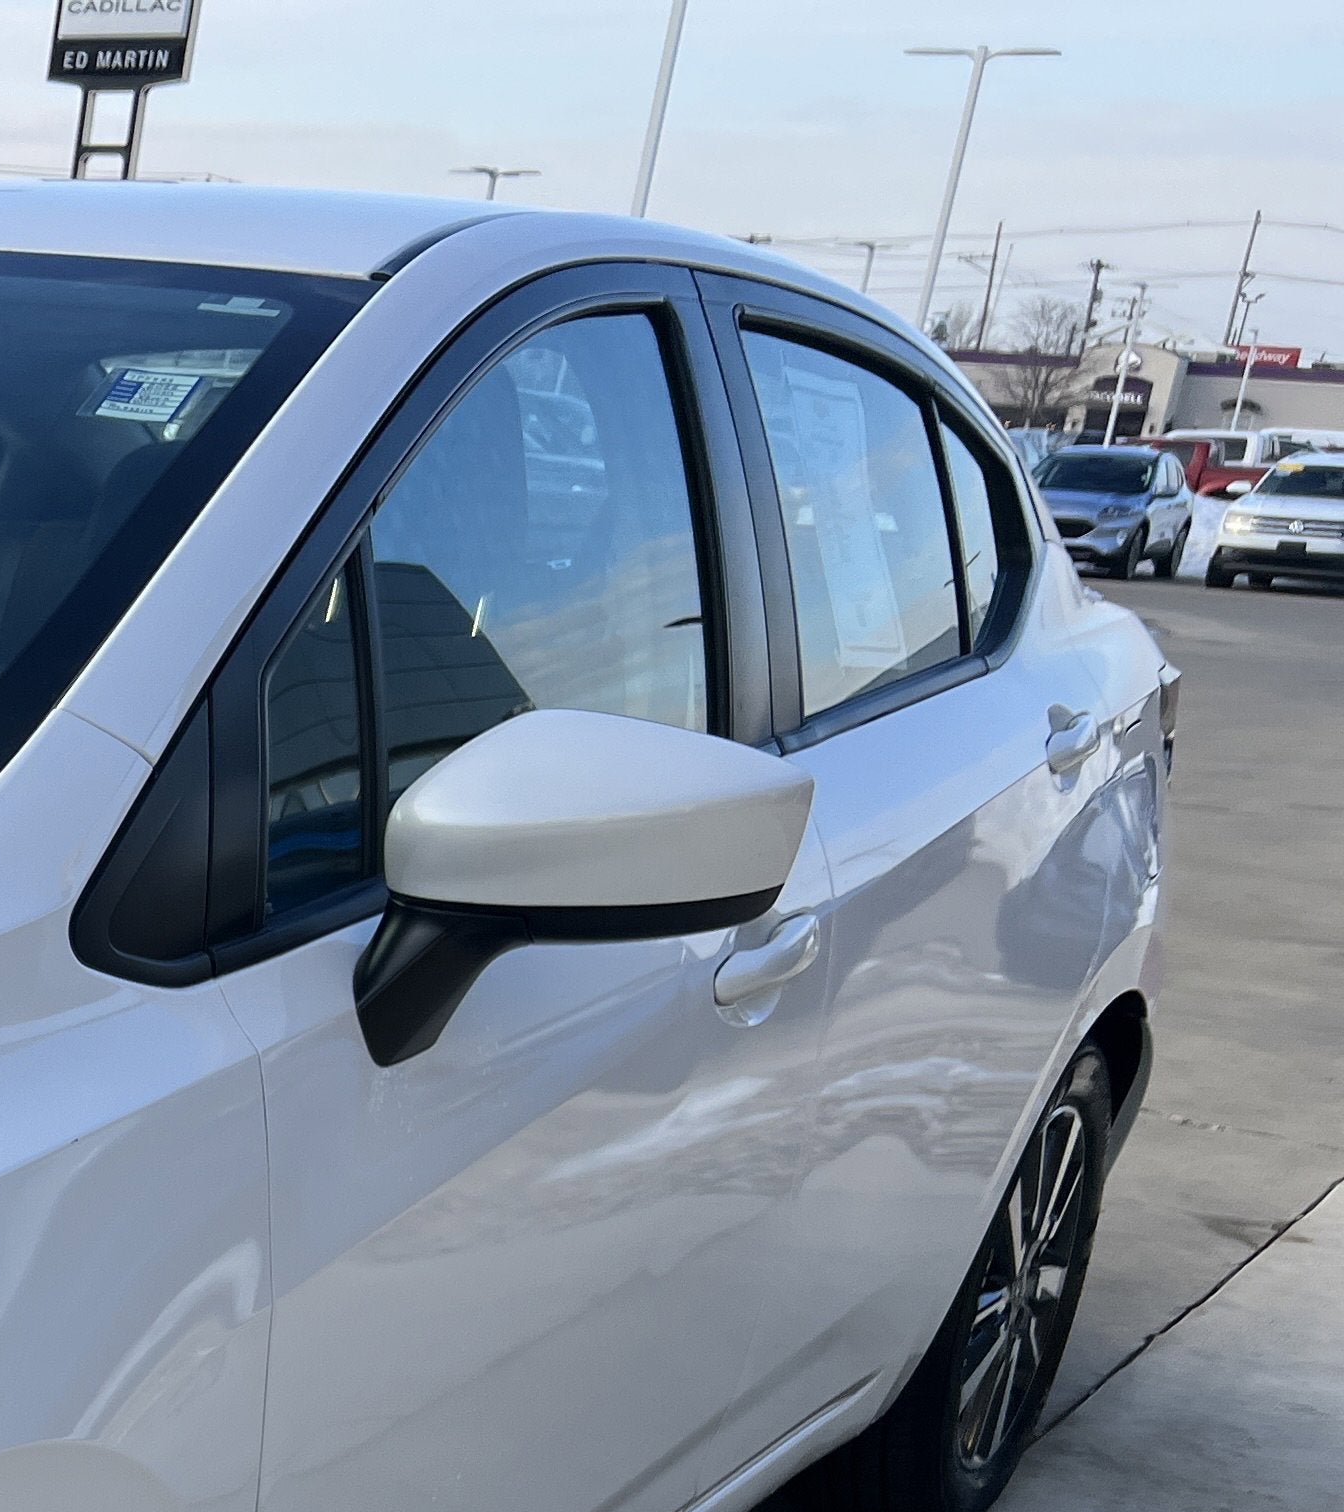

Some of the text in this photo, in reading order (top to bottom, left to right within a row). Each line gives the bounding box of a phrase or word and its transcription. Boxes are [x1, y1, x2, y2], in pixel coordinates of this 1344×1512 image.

[67, 0, 181, 14] CADILLAC
[62, 48, 170, 71] ED MARTIN
